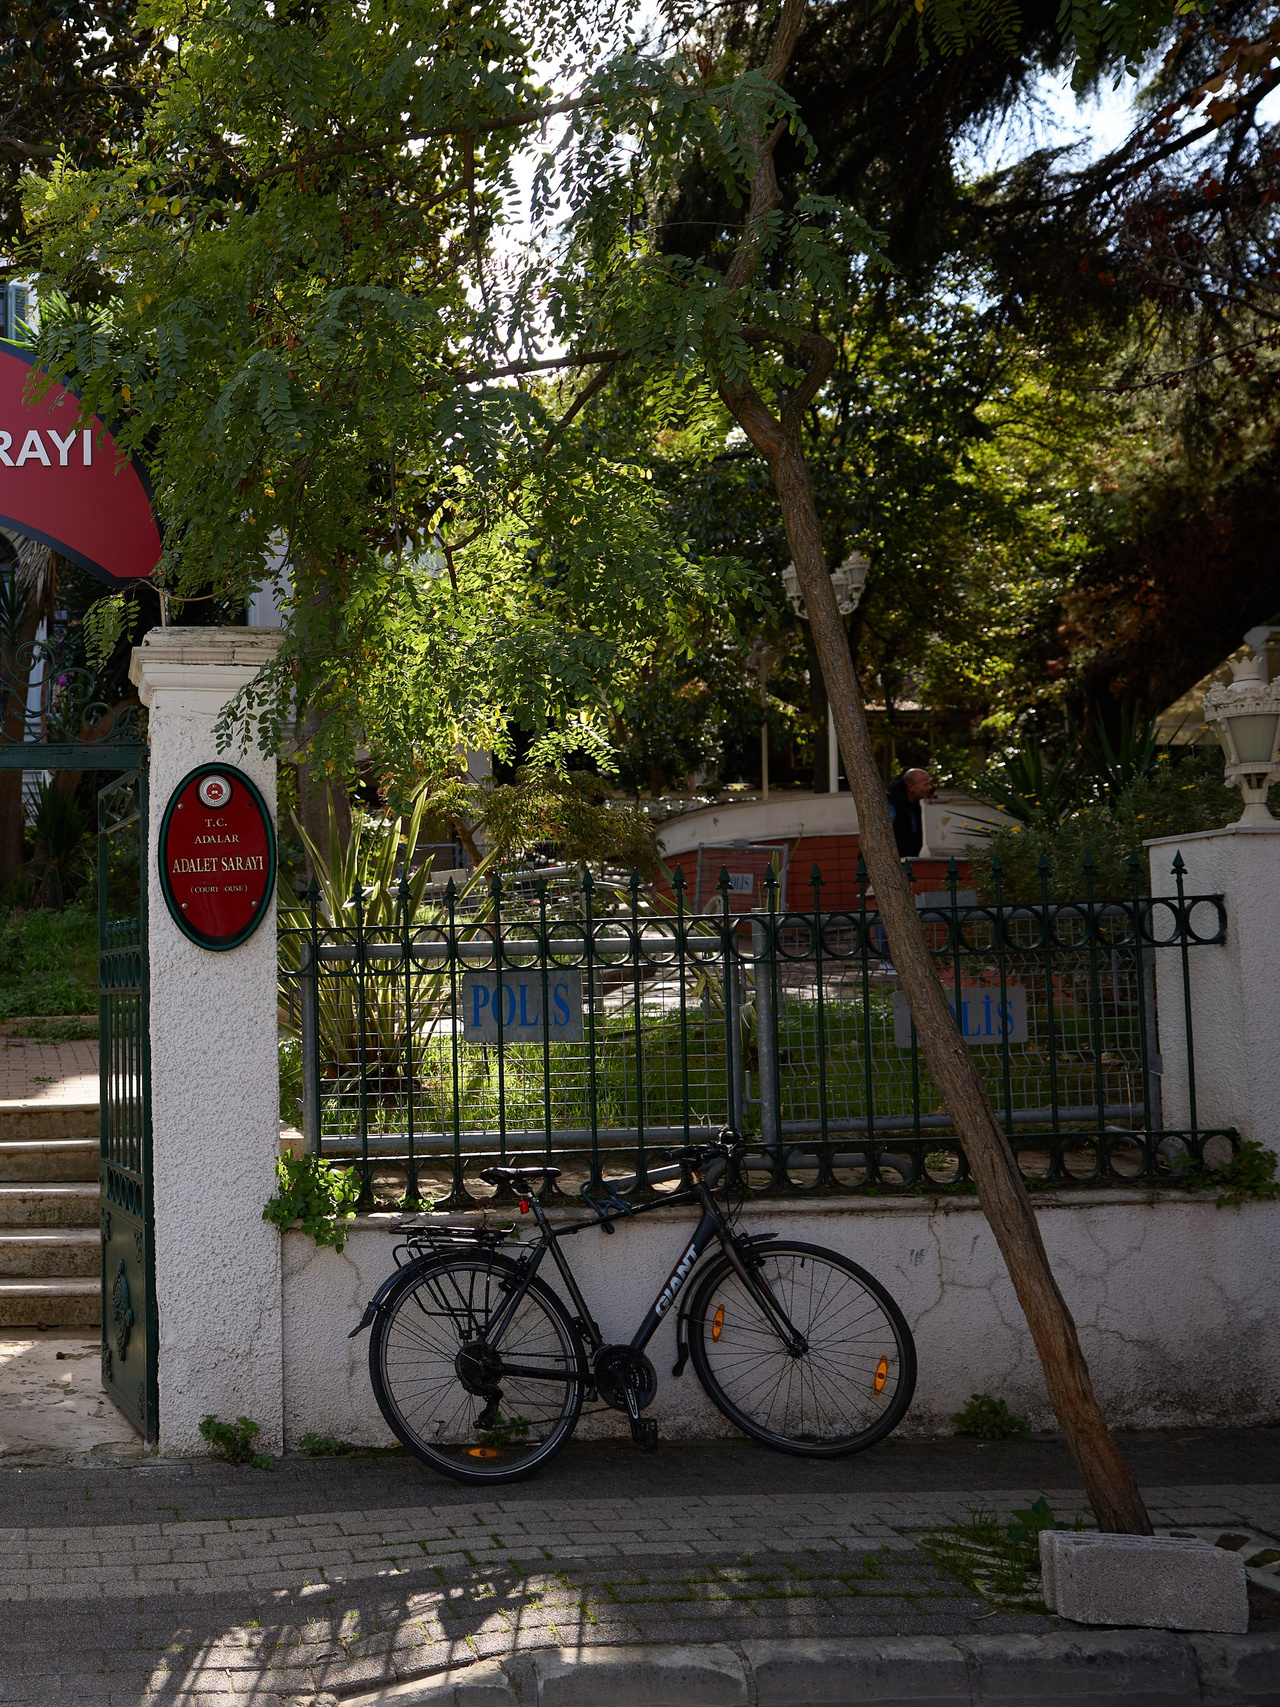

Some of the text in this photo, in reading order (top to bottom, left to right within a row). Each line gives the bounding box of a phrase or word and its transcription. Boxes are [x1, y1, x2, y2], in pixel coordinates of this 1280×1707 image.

[204, 818, 228, 827] T.C.
[194, 834, 240, 844] ADALAR
[172, 855, 264, 873] ADALET SARAYI
[471, 973, 571, 1027] POLS
[907, 994, 1015, 1038] LİS
[655, 1243, 698, 1318] GIANT
